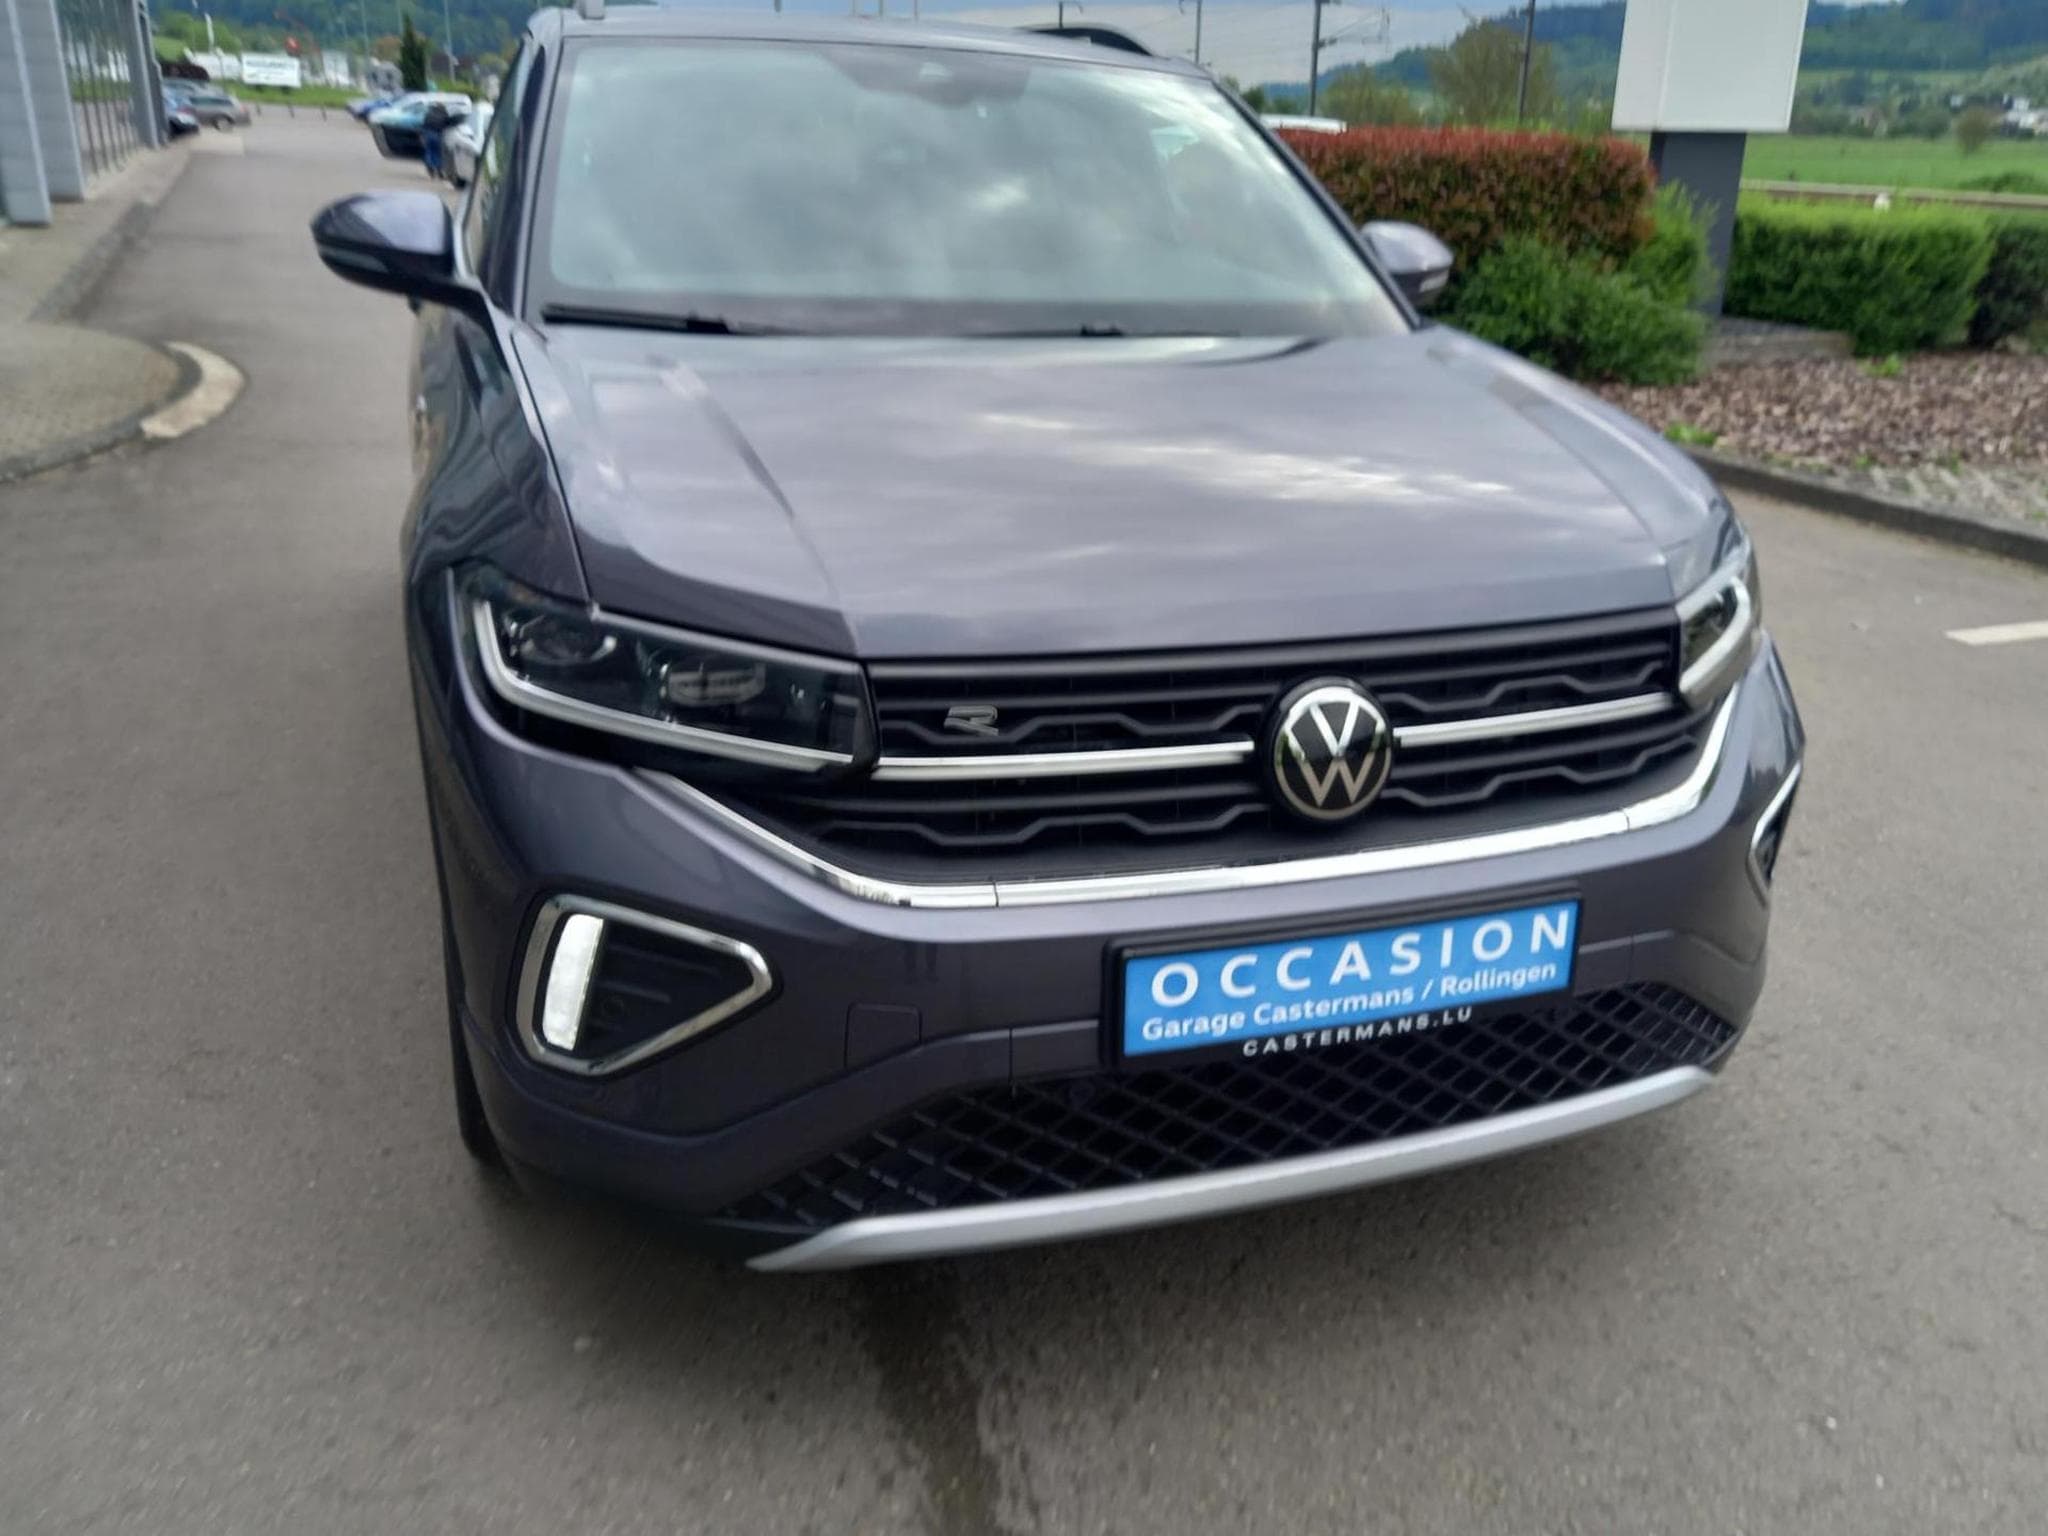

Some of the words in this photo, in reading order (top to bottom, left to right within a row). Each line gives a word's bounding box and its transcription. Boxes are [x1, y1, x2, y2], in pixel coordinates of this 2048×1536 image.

[1151, 910, 1569, 1007] OCCASION
[1141, 1011, 1243, 1042] Garage
[1252, 987, 1415, 1027] Castermans
[1420, 978, 1434, 1001] /
[1440, 962, 1557, 998] Rollingen
[1242, 1005, 1473, 1058] CASTERMANS.LU
